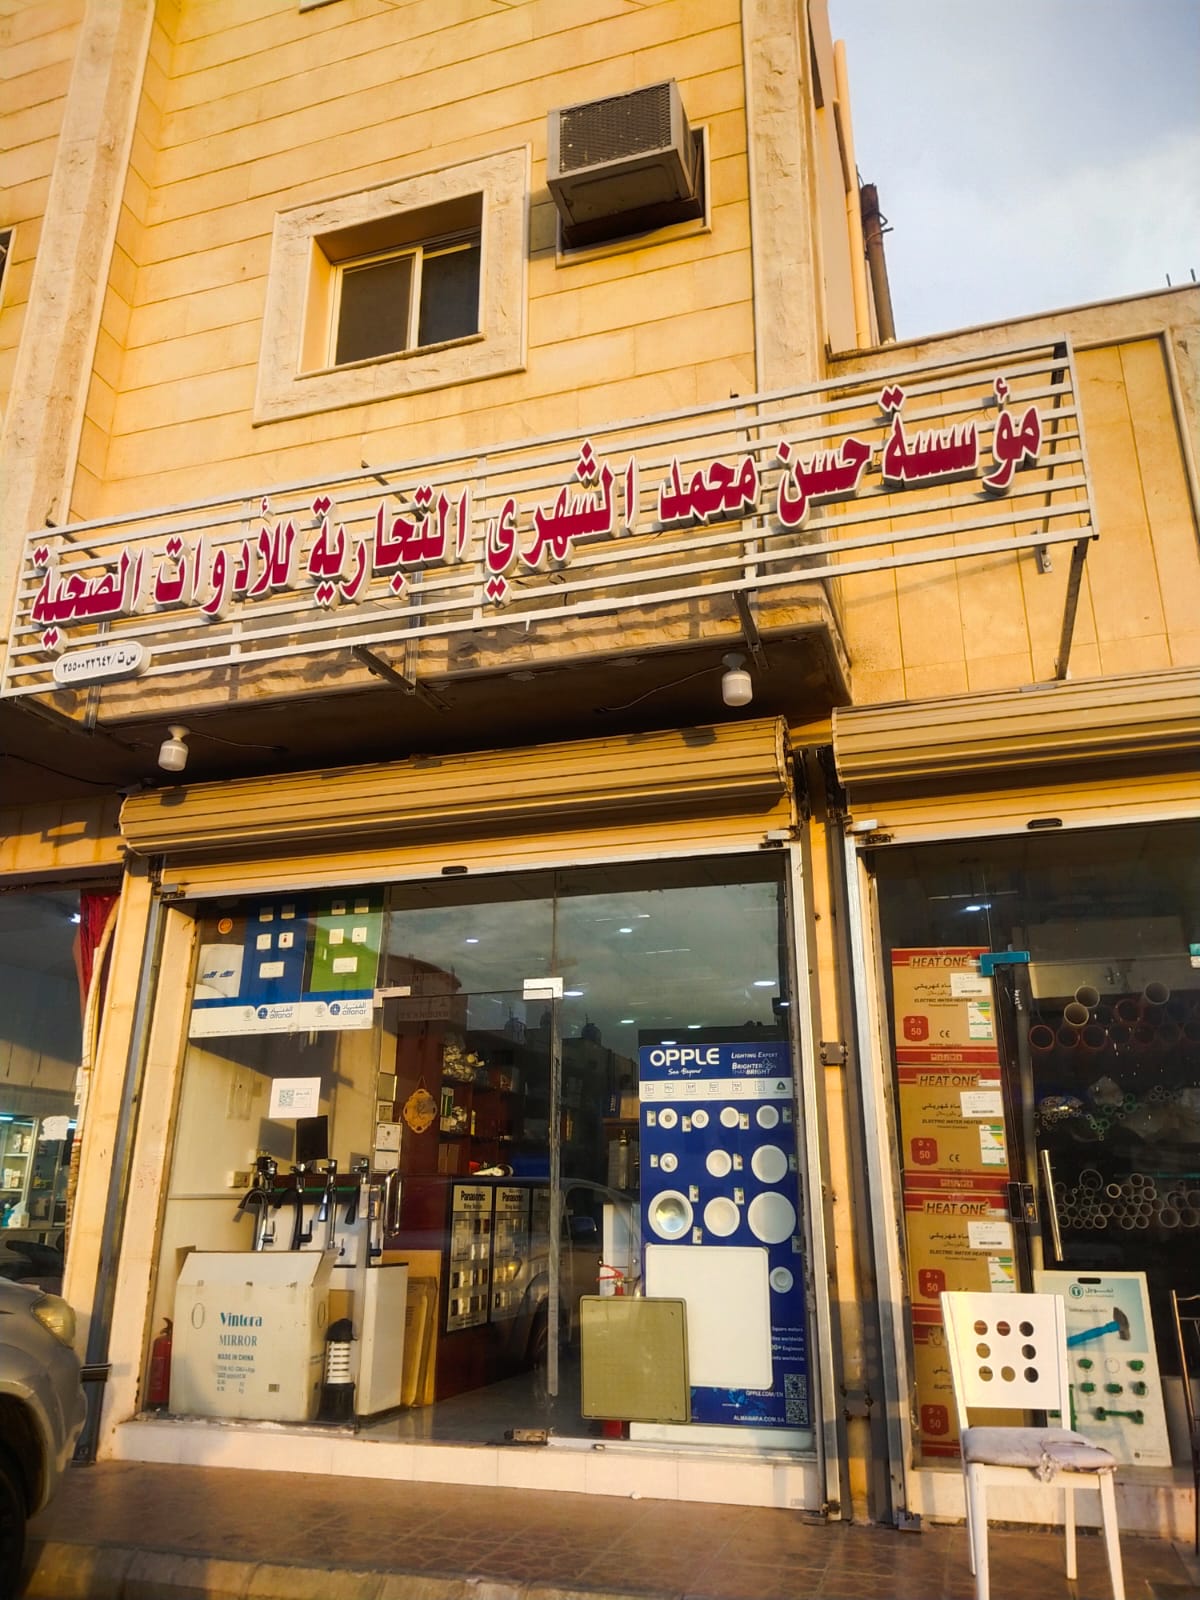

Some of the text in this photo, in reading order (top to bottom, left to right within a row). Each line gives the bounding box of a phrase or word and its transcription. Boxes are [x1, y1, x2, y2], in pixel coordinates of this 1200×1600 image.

[31, 377, 1042, 649] مؤسسة حسن محمد الشهري التجارية للأدوات الصحية
[912, 956, 969, 967] HEAT ONE
[911, 1027, 922, 1036] 50
[649, 1047, 720, 1066] OPPLE
[919, 1075, 979, 1087] HEAT ONE
[919, 1150, 931, 1160] 50
[460, 1190, 486, 1201] Panasonic
[926, 1202, 987, 1215] HEAT ONE
[927, 1282, 938, 1292] 50
[219, 1334, 258, 1347] MIRROR
[217, 1353, 231, 1361] MADE
[929, 1418, 941, 1429] 50
